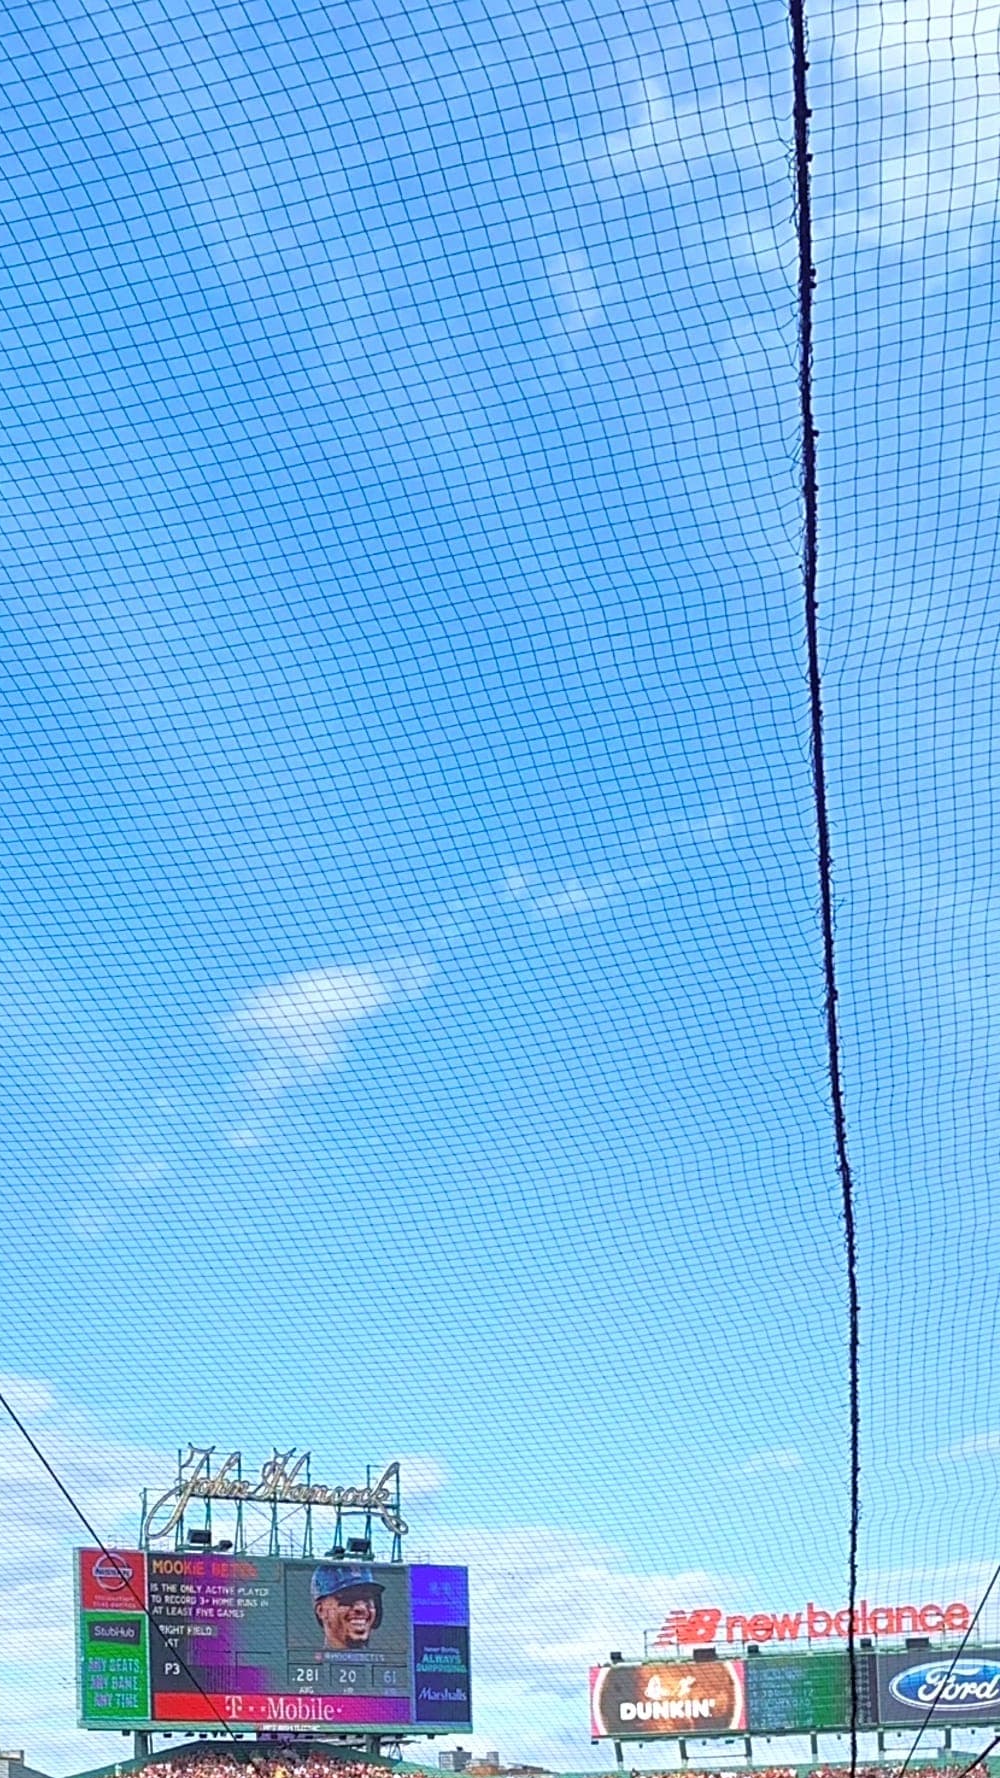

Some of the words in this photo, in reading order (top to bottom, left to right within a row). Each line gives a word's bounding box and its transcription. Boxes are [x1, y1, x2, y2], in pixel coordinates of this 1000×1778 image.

[145, 1443, 251, 1539] John
[257, 1447, 408, 1534] Hancock
[152, 1560, 205, 1576] MOOKIE
[162, 1583, 178, 1593] THE
[205, 1585, 234, 1595] ACTIVE
[151, 1595, 161, 1603] TO
[164, 1595, 197, 1605] RECORD
[212, 1598, 233, 1606] HOME
[152, 1607, 163, 1616] AT
[166, 1607, 192, 1616] LEAST
[196, 1608, 215, 1617] FIVE
[217, 1609, 245, 1618] GAMES
[94, 1626, 135, 1638] StubHub
[187, 1626, 212, 1636] FIELD
[423, 1654, 461, 1664] ALWAYS
[165, 1663, 180, 1675] P3
[292, 1668, 319, 1682] .281
[339, 1669, 356, 1683] 20
[917, 1668, 1000, 1702] Ford
[418, 1687, 467, 1701] Marshalls
[620, 1699, 716, 1721] DUNKIN'
